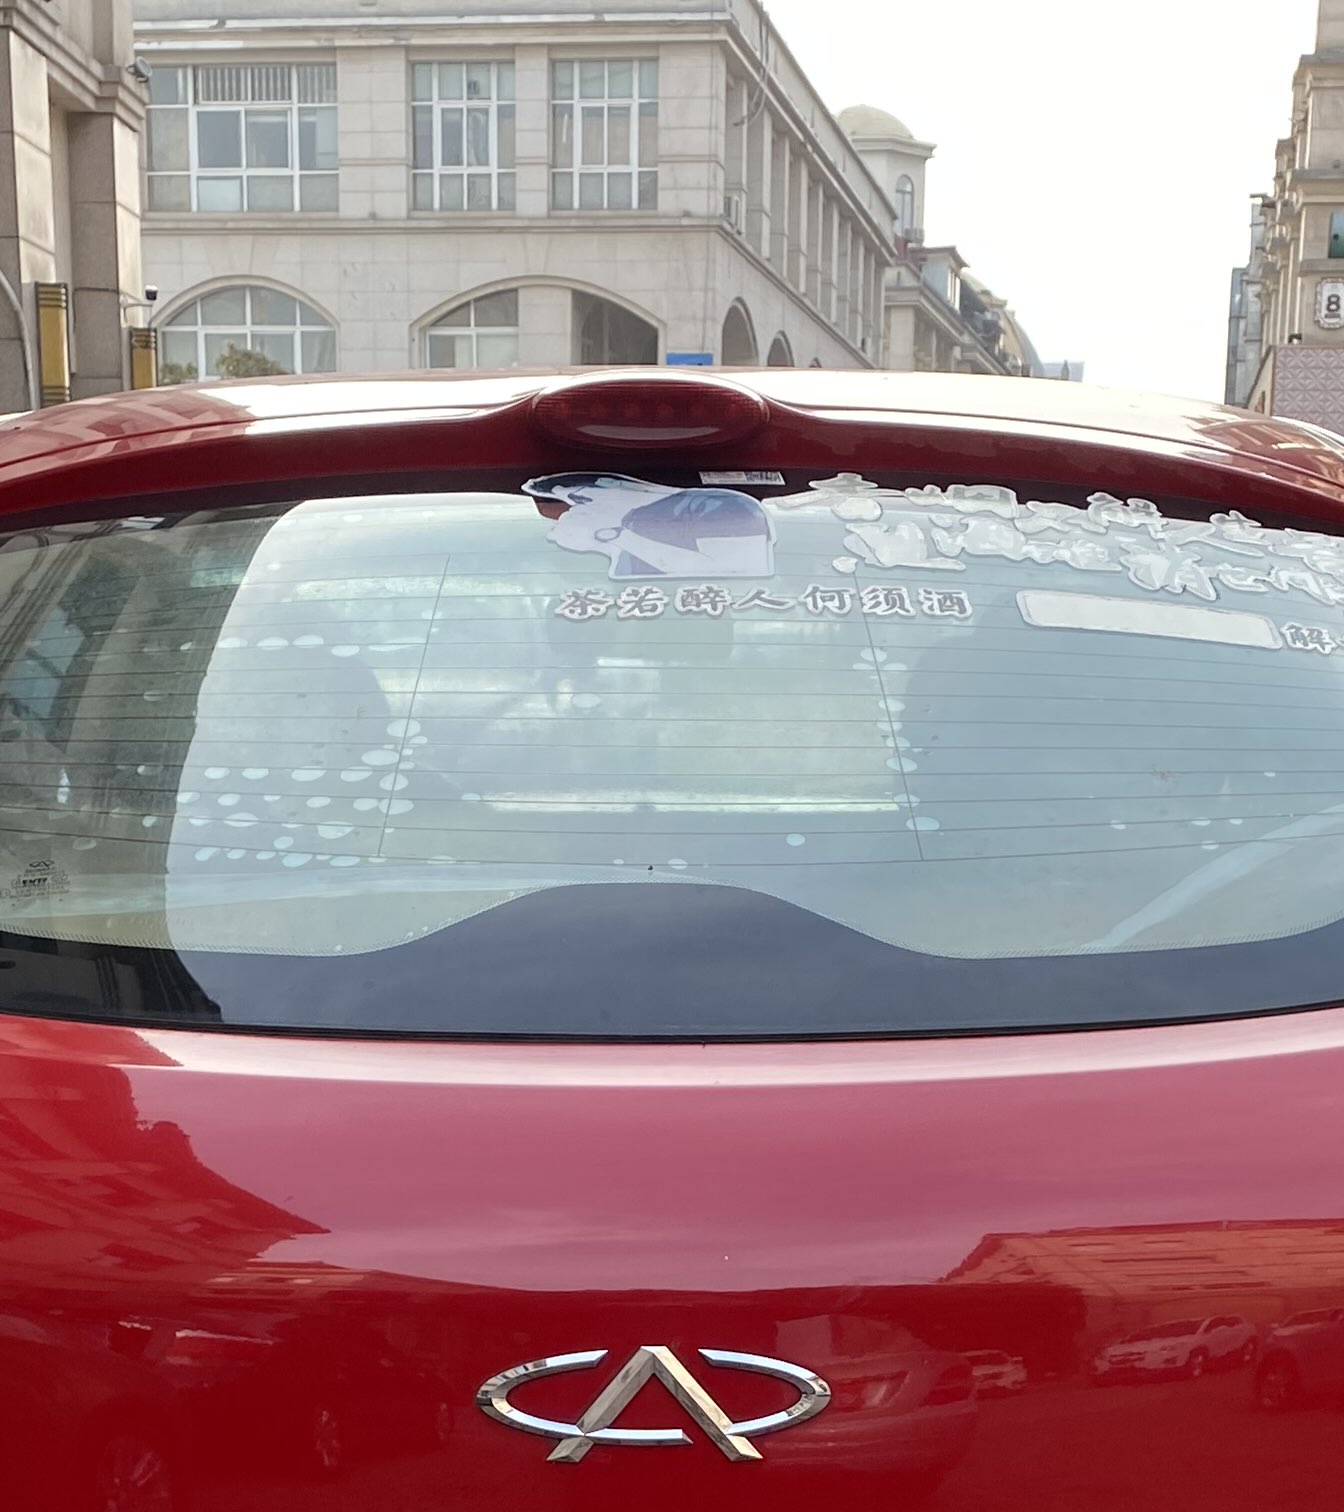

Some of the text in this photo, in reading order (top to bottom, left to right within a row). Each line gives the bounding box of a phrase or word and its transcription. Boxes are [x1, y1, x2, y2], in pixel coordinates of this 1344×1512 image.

[556, 584, 972, 618] 茶若醉人何须酒
